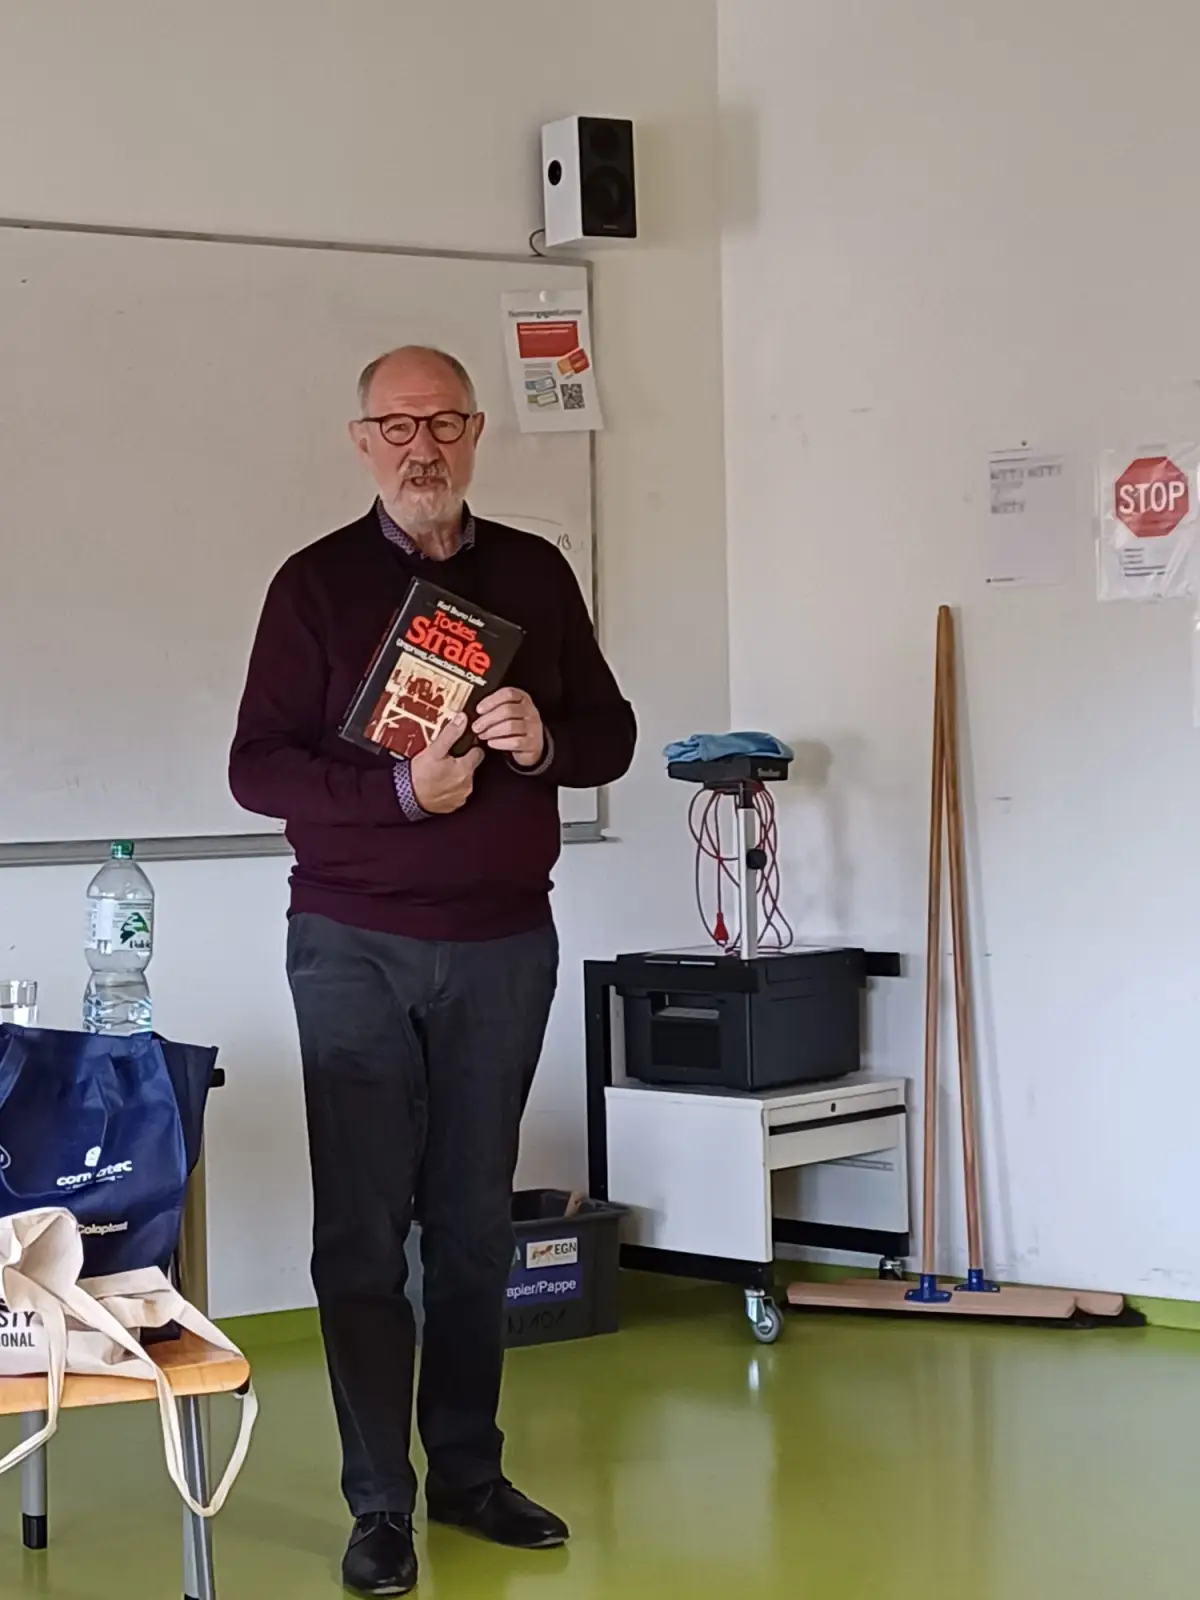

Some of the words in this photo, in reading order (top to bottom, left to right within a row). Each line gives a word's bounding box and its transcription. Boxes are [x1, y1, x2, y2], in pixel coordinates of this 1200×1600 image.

[1119, 481, 1185, 514] STOP
[433, 609, 478, 641] Todes
[405, 615, 491, 676] Strafe
[554, 1243, 577, 1255] EGN
[506, 1280, 577, 1299] apier/Pappe
[0, 1332, 36, 1347] ONAL
